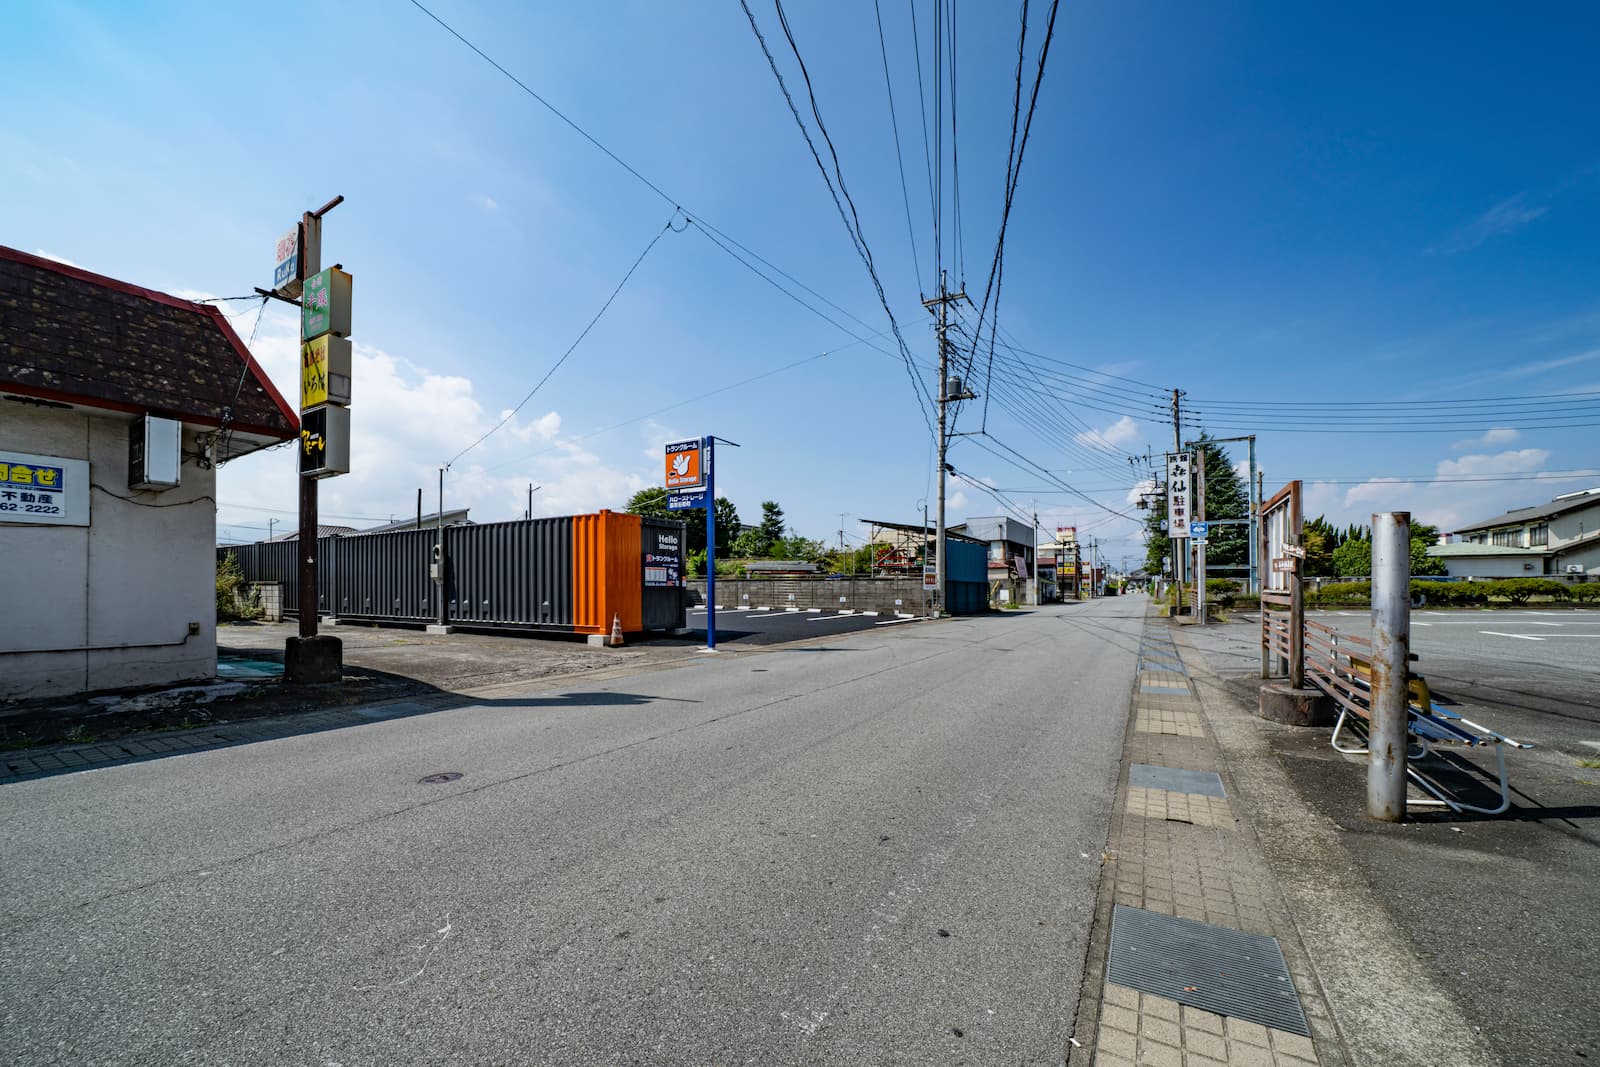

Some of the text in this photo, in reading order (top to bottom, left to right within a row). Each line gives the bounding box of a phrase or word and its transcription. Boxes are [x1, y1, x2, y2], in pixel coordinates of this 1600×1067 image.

[666, 442, 697, 453] トランクルーム
[2, 491, 53, 504] 不動産
[669, 493, 703, 502] ハローストレージ
[659, 535, 678, 544] Hello
